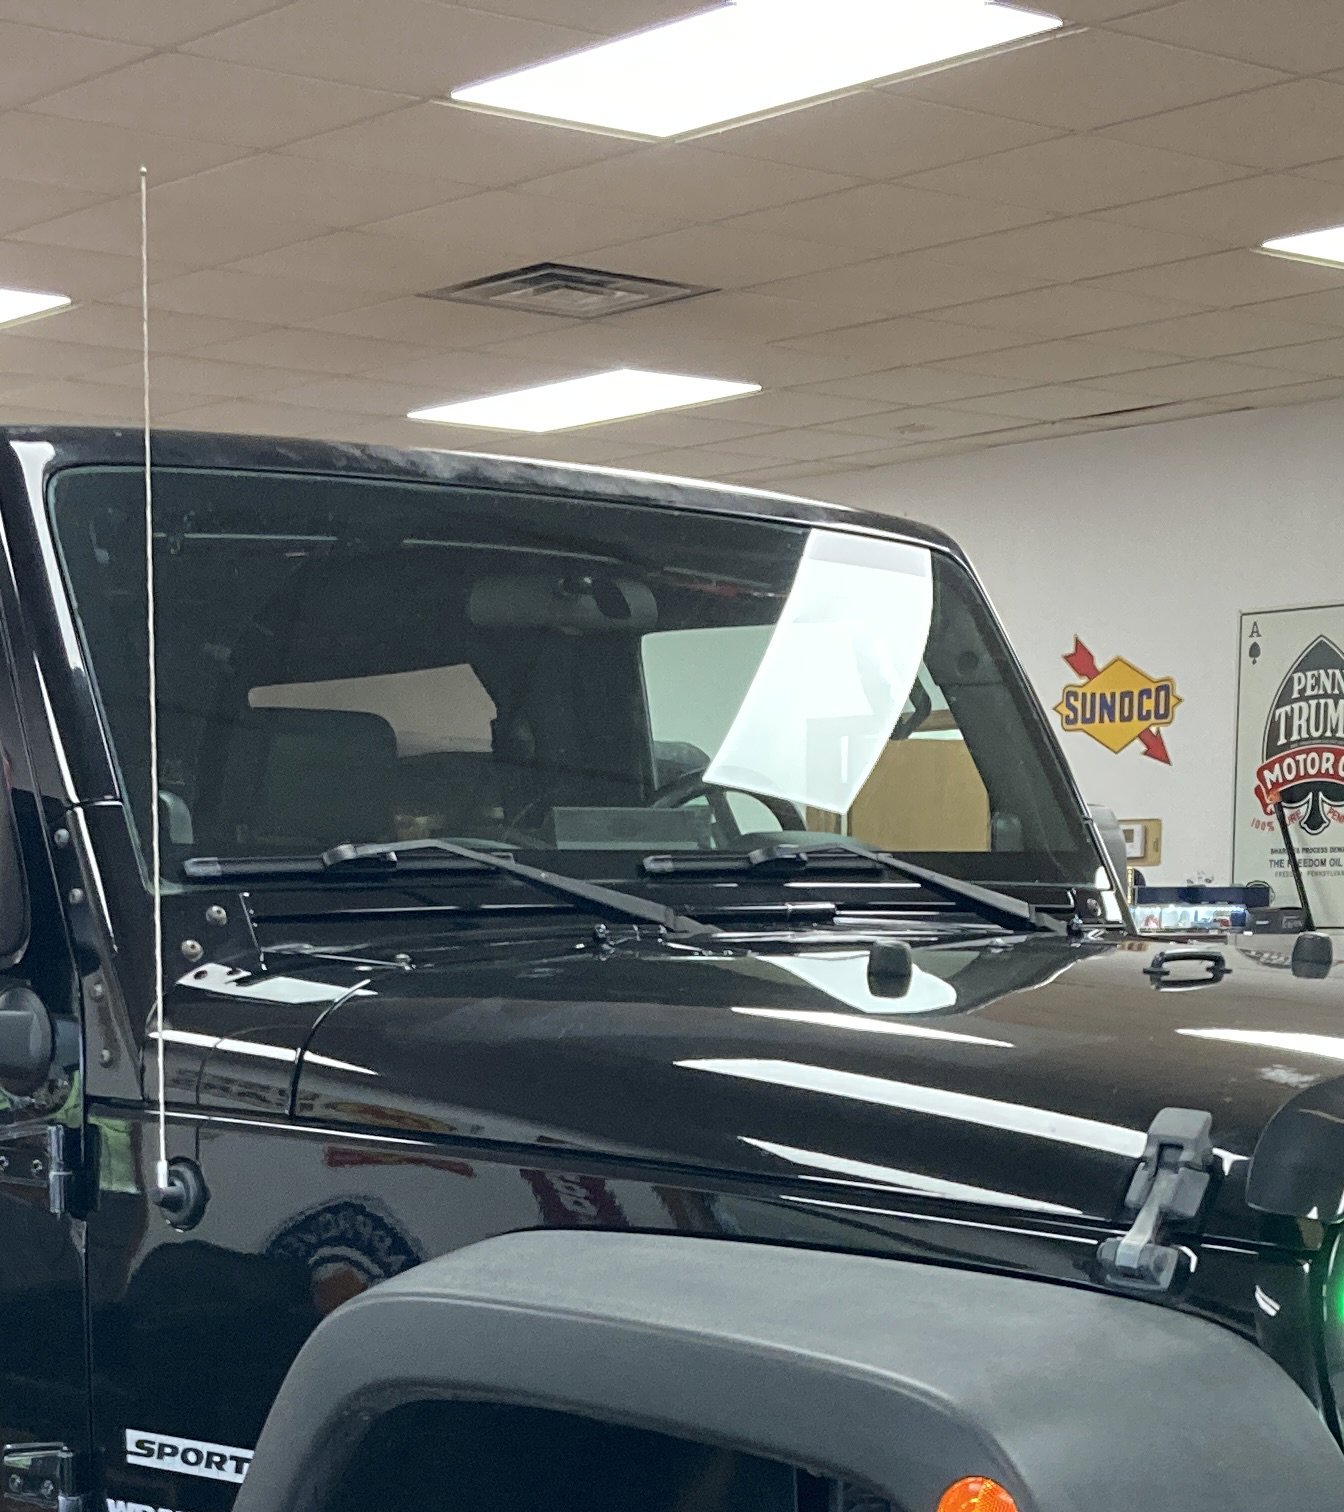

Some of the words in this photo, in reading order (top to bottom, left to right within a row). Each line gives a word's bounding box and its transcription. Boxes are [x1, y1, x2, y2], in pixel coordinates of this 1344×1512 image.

[1248, 621, 1262, 638] A
[1064, 683, 1171, 726] SUNOCO
[1263, 752, 1334, 788] MOTOR
[1250, 818, 1276, 832] 100%
[1269, 859, 1285, 868] THE
[1287, 858, 1326, 868] FEEDOM
[1329, 858, 1343, 867] OIL
[127, 1438, 252, 1475] SPORT
